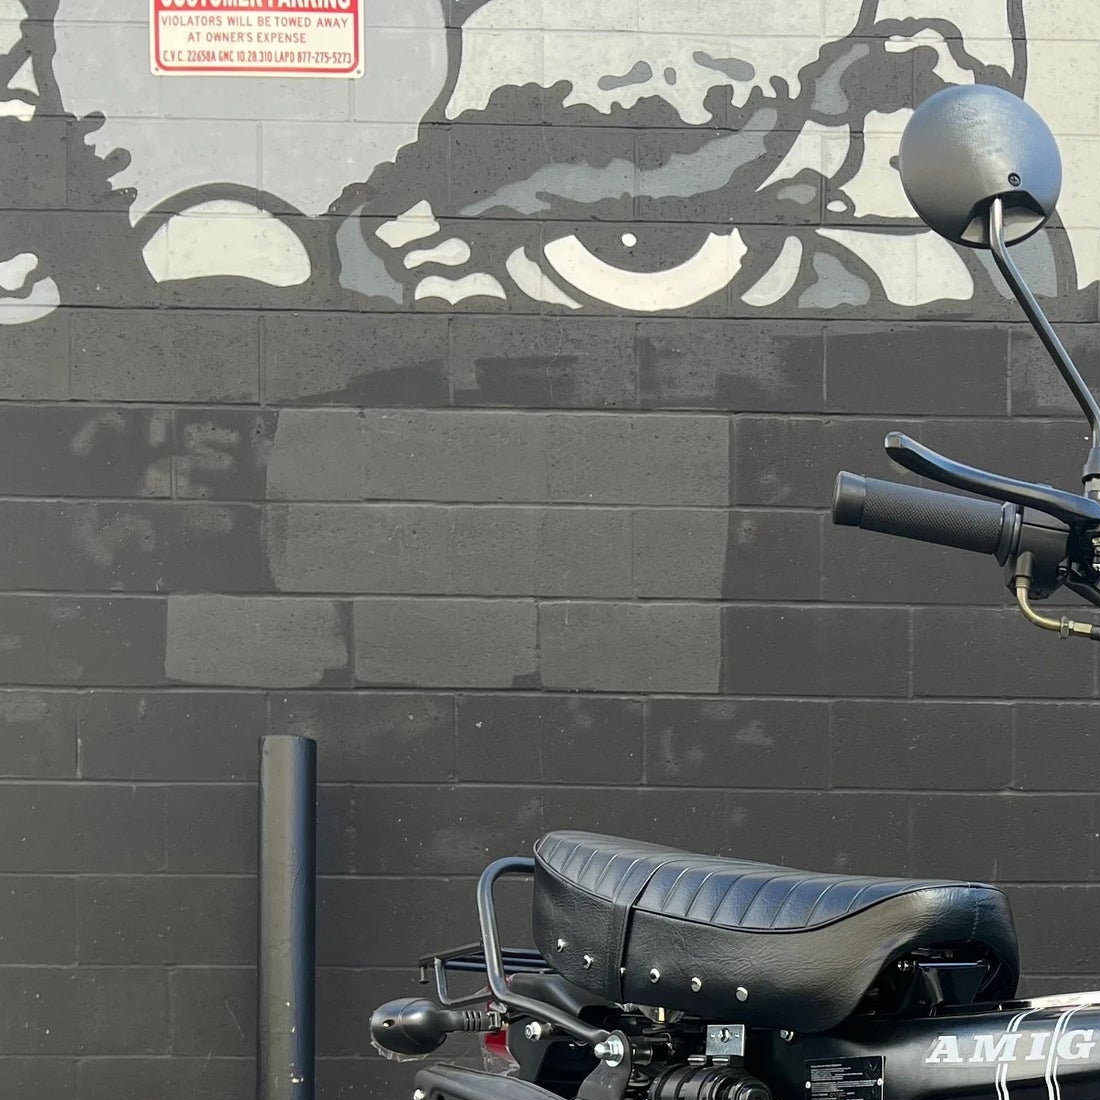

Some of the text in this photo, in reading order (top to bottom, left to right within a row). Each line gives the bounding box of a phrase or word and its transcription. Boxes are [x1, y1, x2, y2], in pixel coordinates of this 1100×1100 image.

[161, 16, 348, 28] VIOLATORS WILL BE TOWED AWAY
[187, 32, 306, 43] AT OWNER'S EXPENSE
[187, 50, 216, 62] 22658A
[274, 51, 295, 63] LAPD
[297, 51, 352, 64] 877-275-5273
